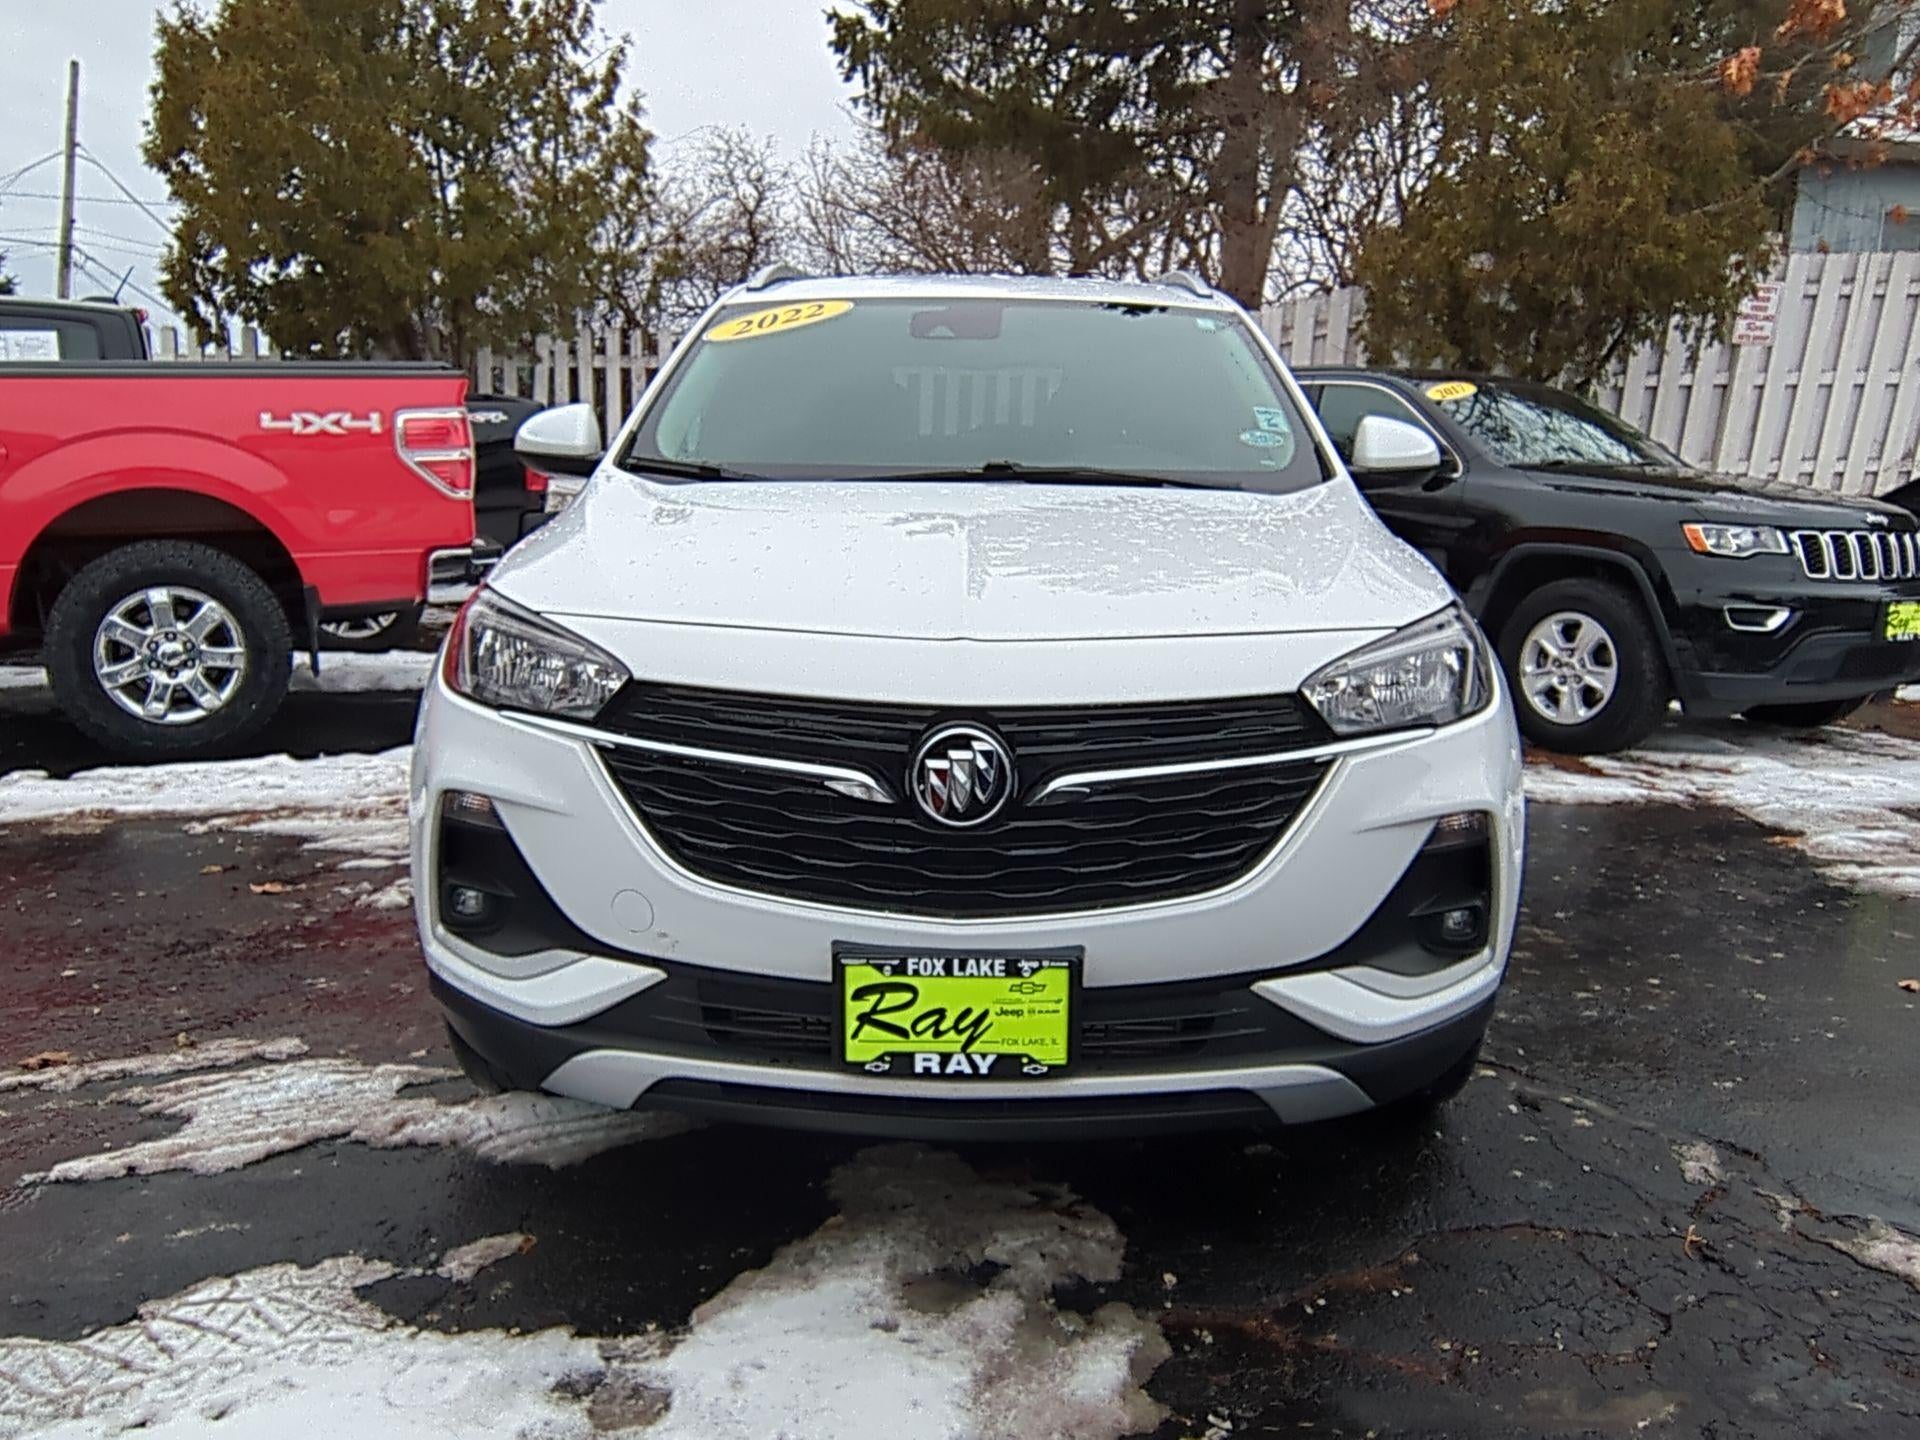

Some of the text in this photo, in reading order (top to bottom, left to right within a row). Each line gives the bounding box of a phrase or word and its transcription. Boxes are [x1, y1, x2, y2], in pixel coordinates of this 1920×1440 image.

[732, 303, 825, 337] 2022
[907, 957, 1006, 977] FOX LAKE
[850, 981, 994, 1054] Ray
[995, 1006, 1024, 1018] Jeep
[1001, 1038, 1020, 1046] FOX
[913, 1053, 998, 1075] RAY
